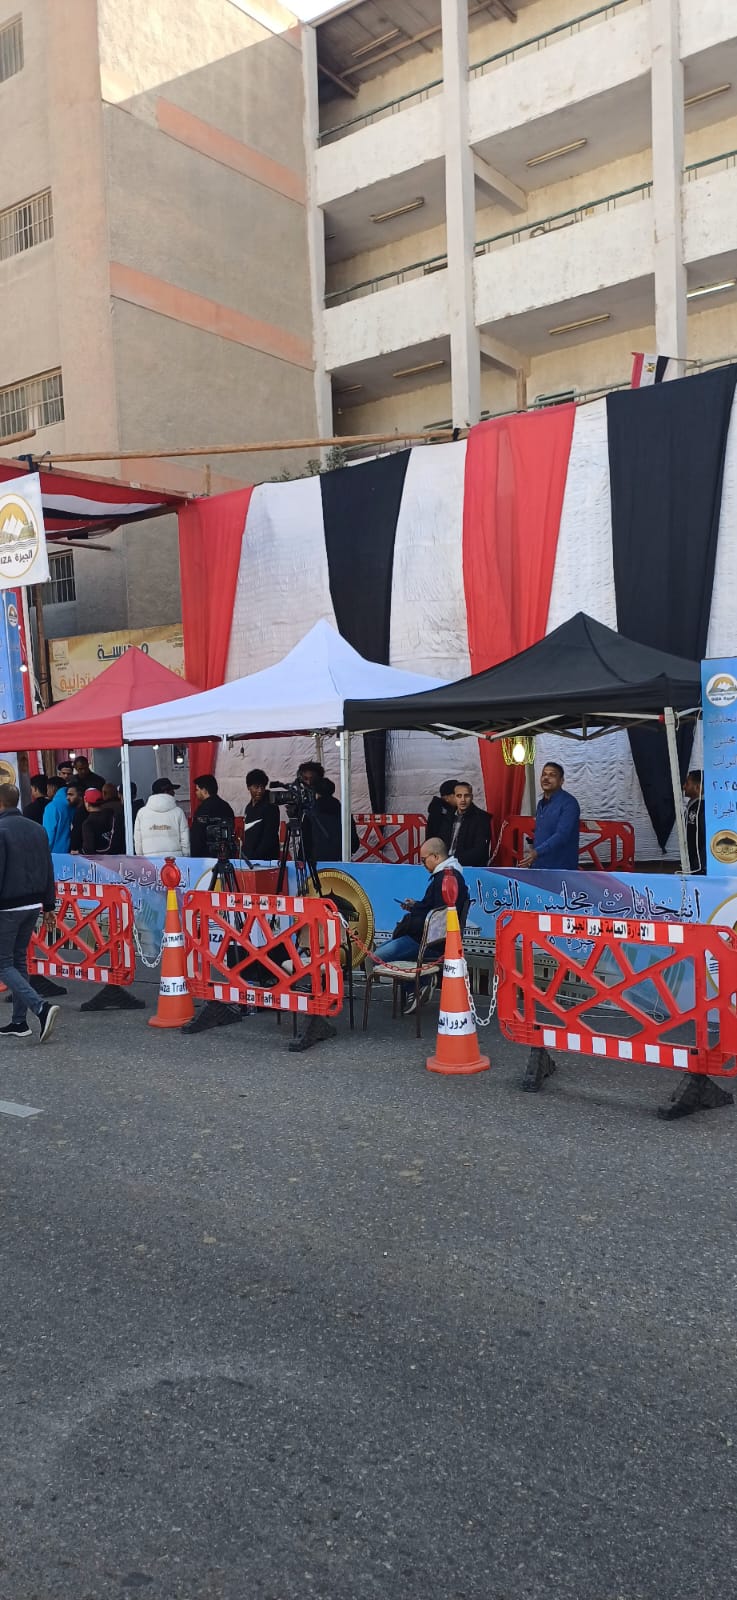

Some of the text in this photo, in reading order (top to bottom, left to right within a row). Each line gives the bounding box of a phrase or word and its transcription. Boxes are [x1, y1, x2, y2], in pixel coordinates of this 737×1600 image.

[0, 556, 12, 564] IZA
[14, 549, 33, 563] الجيزة
[598, 885, 701, 919] انتخابات
[208, 933, 224, 943] IZA
[240, 991, 281, 1005] Giza Traffic
